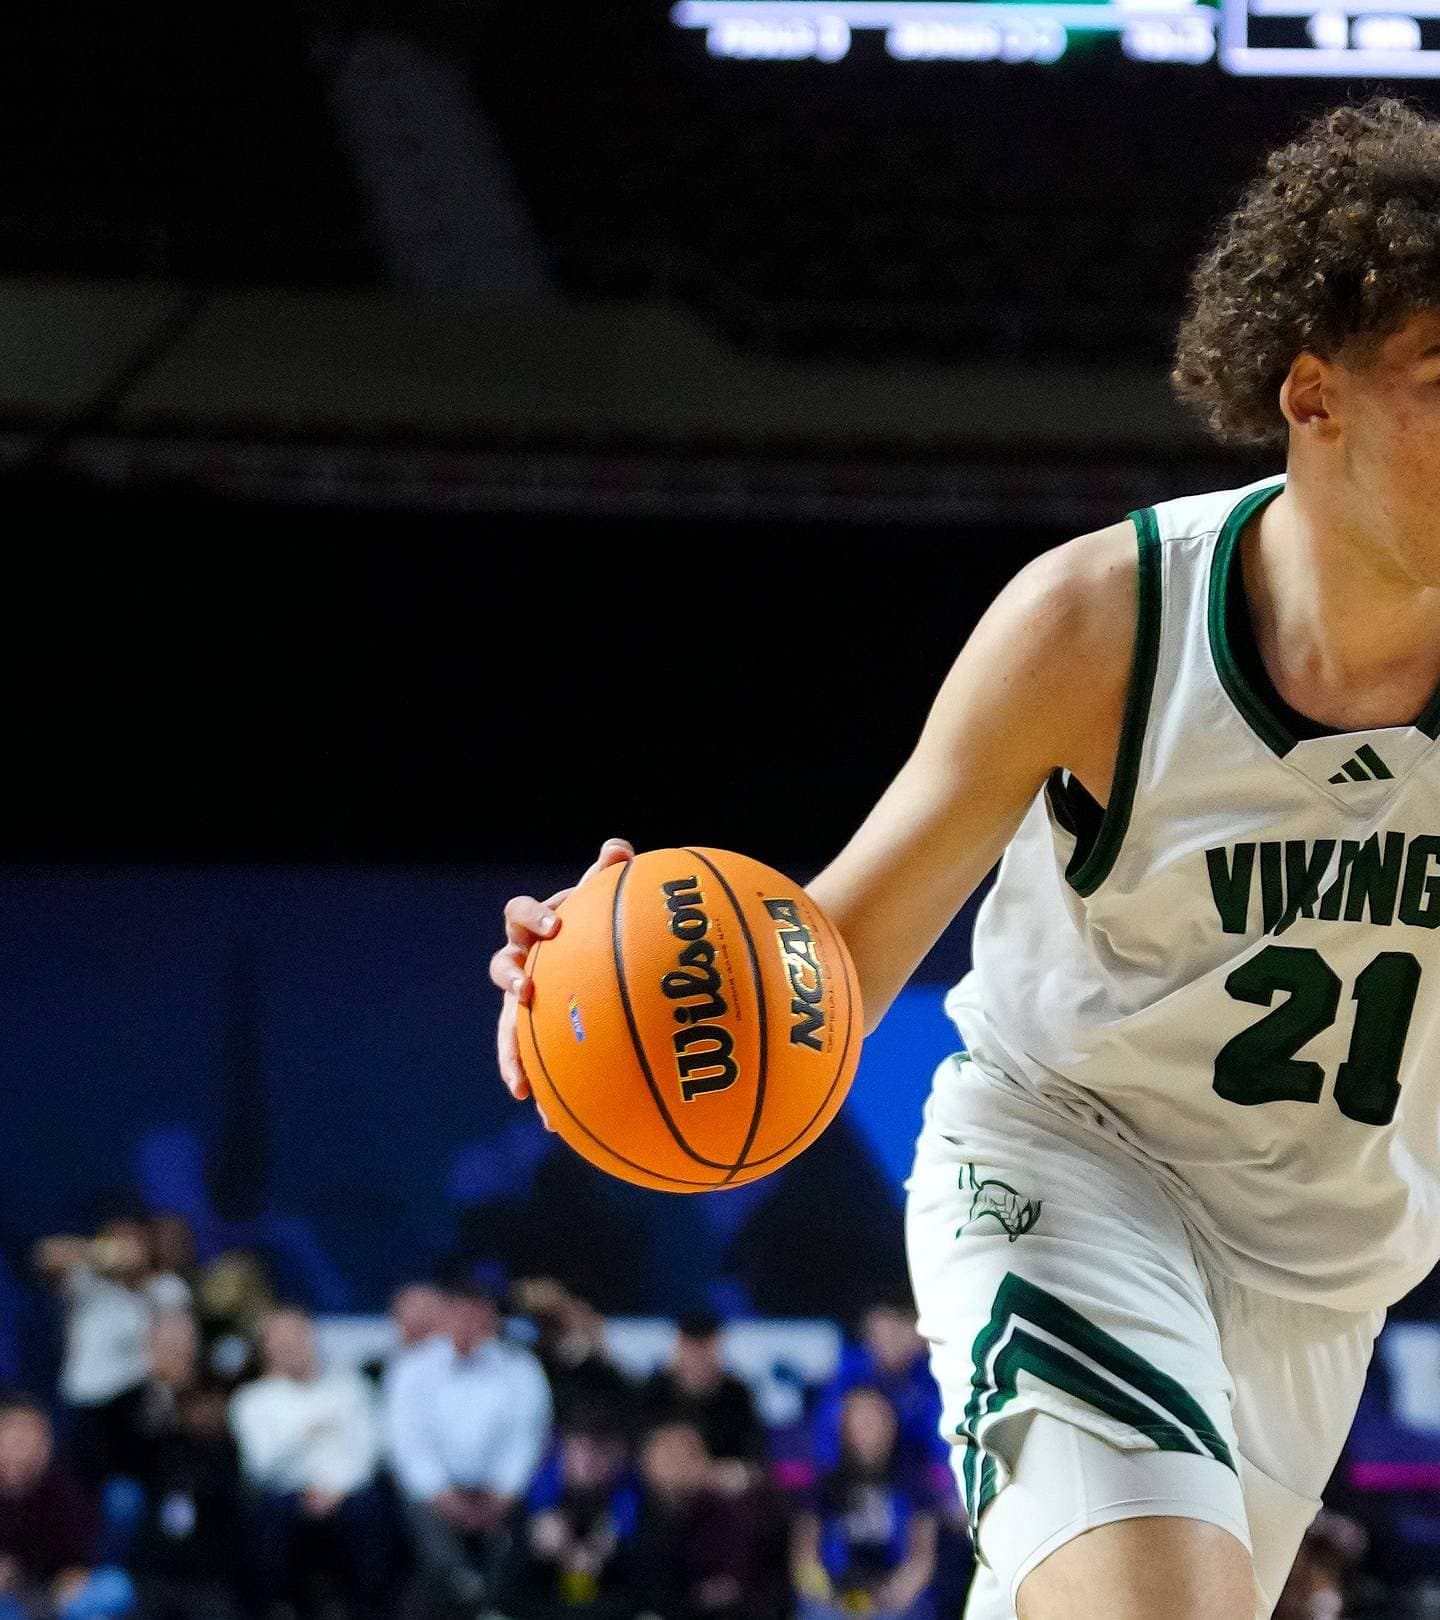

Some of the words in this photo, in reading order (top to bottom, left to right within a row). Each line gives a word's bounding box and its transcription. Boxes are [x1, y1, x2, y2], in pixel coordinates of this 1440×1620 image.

[660, 875, 741, 1103] Wilson
[762, 897, 826, 1054] NCAA
[1212, 944, 1423, 1127] 21
